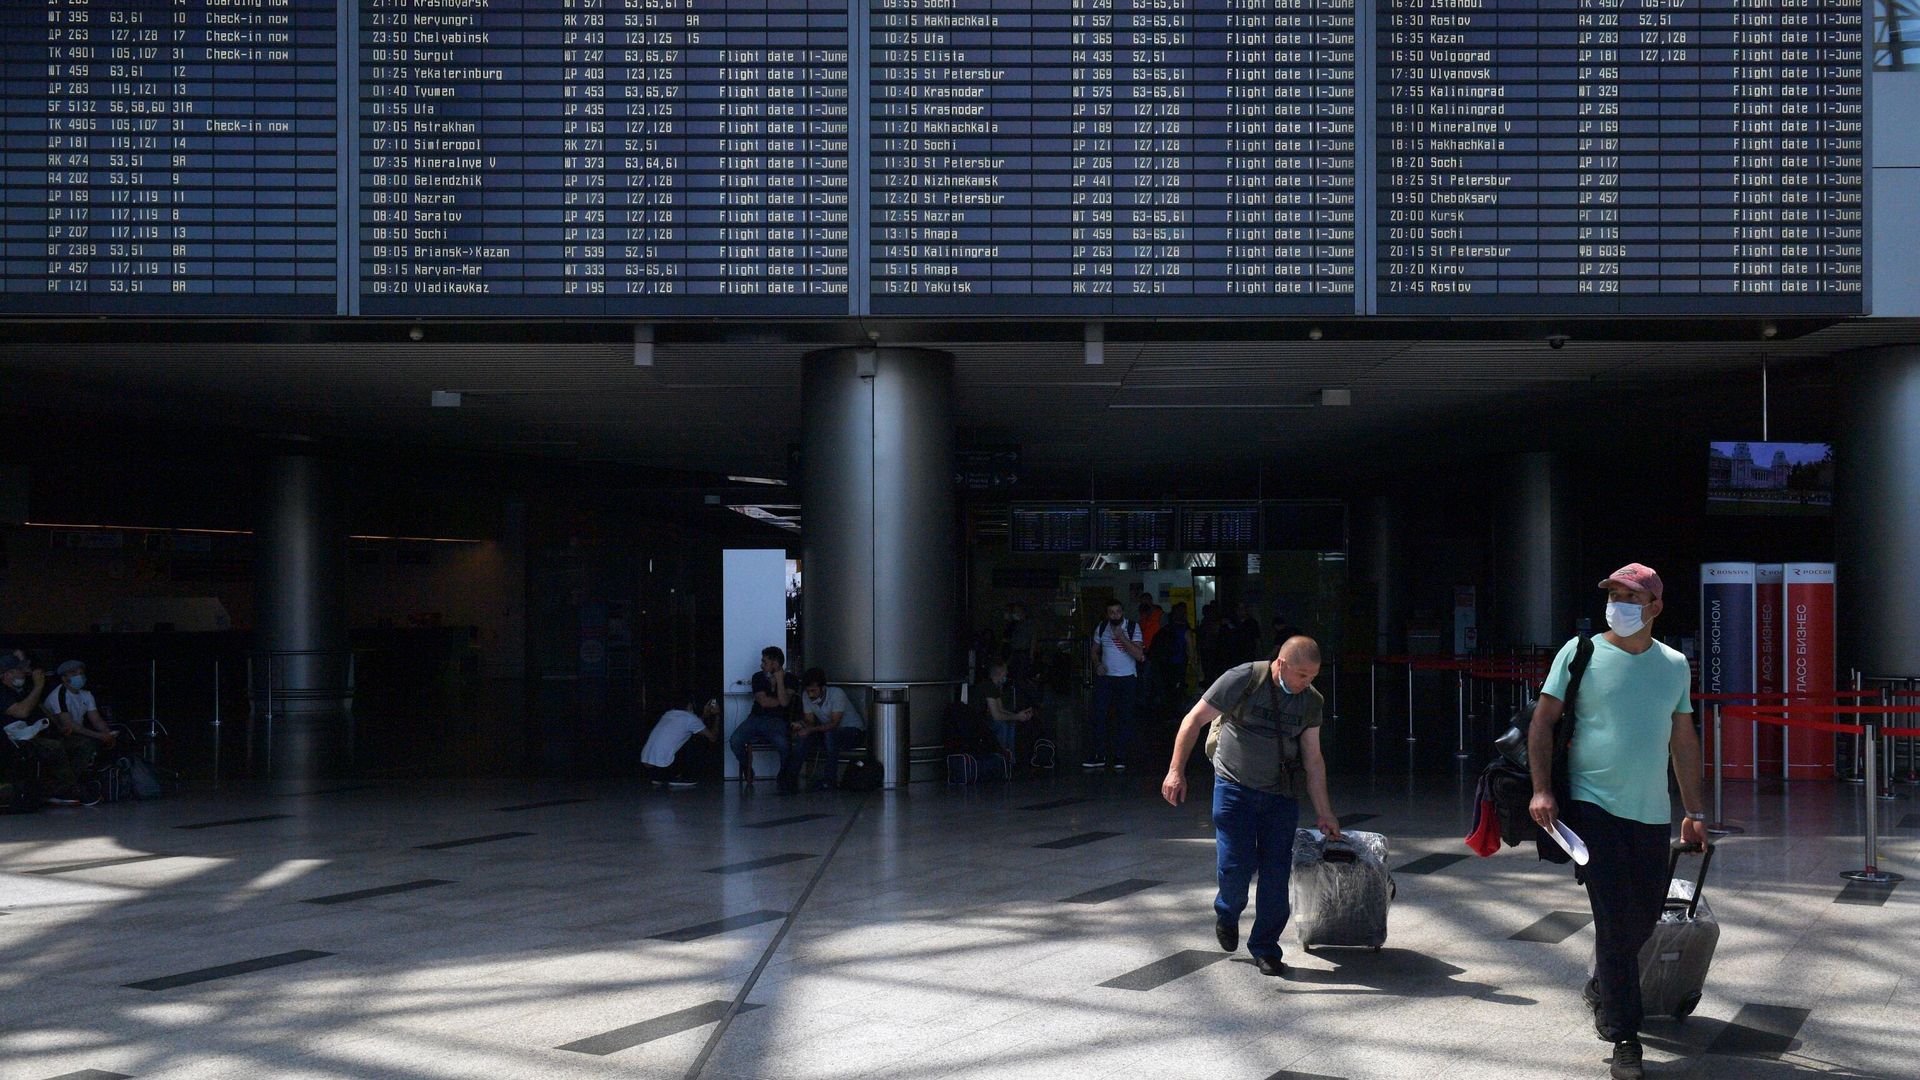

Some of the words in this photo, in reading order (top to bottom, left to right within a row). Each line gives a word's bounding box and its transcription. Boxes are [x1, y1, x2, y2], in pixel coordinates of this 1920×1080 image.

[68, 12, 88, 22] 395
[110, 12, 142, 24] 63,61
[174, 12, 186, 24] 10
[268, 16, 288, 24] now
[1392, 32, 1424, 44] 16:35
[1430, 32, 1464, 44] Kazan
[1598, 32, 1618, 44] 283
[1640, 32, 1686, 44] 127,128
[1734, 32, 1772, 44] Flight
[1782, 32, 1808, 42] date
[1816, 32, 1862, 42] 11-June
[68, 46, 94, 58] 4901
[112, 48, 158, 60] 105,107
[172, 48, 184, 58] 31
[268, 52, 288, 60] now
[372, 50, 406, 60] 00:50
[414, 50, 454, 62] Surgut
[584, 50, 604, 62] 247
[624, 50, 678, 62] 63,65,67
[720, 50, 758, 62] Flight
[768, 50, 794, 62] date
[802, 50, 848, 62] 11-June
[886, 50, 918, 62] 10:25
[924, 50, 964, 62] Elista
[1092, 50, 1112, 62] 435
[1132, 50, 1164, 62] 52,51
[1226, 50, 1266, 62] Flight
[1274, 50, 1300, 62] date
[1310, 50, 1354, 62] 11-June
[1392, 50, 1424, 62] 16:50
[1430, 50, 1490, 62] Volgograd
[1600, 50, 1616, 62] 181
[1640, 50, 1686, 62] 127,128
[1734, 50, 1772, 62] Flight
[1782, 50, 1808, 60] date
[1816, 48, 1862, 60] 11-June
[68, 64, 88, 76] 459
[110, 66, 142, 78] 63,61
[174, 66, 186, 76] 12
[68, 100, 96, 112] 5132
[110, 100, 164, 114] 56,58,60
[374, 102, 408, 114] 01:55
[414, 104, 434, 114] Ufa
[584, 104, 604, 114] 435
[626, 104, 672, 116] 123,125
[720, 104, 758, 116] Flight
[768, 104, 794, 116] date
[802, 104, 848, 116] 11-June
[886, 104, 918, 114] 11:15
[924, 104, 984, 114] Krasnodar
[1094, 104, 1112, 116] 157
[1134, 104, 1180, 116] 127,128
[1226, 104, 1266, 116] Flight
[1274, 104, 1300, 114] date
[1310, 104, 1354, 114] 11-June
[1392, 104, 1424, 114] 18:10
[1430, 104, 1504, 116] Kaliningrad
[1598, 104, 1618, 114] 265
[1734, 102, 1772, 114] Flight
[1782, 102, 1808, 114] date
[1816, 102, 1862, 114] 11-June
[70, 136, 86, 148] 181
[112, 136, 156, 150] 119,121
[174, 138, 186, 148] 14
[374, 138, 408, 150] 07:10
[414, 138, 480, 152] Simferopol
[584, 140, 602, 150] 271
[626, 140, 656, 152] 52,51
[720, 140, 758, 152] Flight
[768, 140, 794, 150] date
[802, 140, 848, 150] 11-June
[884, 156, 918, 168] 11:30
[924, 156, 936, 168] St
[944, 156, 1004, 168] Petersbur
[1092, 158, 1112, 168] 205
[1134, 158, 1180, 170] 127,128
[1226, 158, 1266, 170] Flight
[1274, 158, 1300, 168] date
[1308, 158, 1354, 168] 11-June
[1392, 156, 1424, 168] 18:20
[1430, 156, 1462, 168] Sochi
[1600, 156, 1618, 168] 117
[1734, 156, 1772, 168] Flight
[1782, 156, 1808, 166] date
[1816, 156, 1862, 166] 11-June
[68, 172, 88, 184] 202
[110, 172, 142, 184] 53,51
[172, 174, 180, 184] 9
[374, 192, 408, 204] 08:00
[414, 192, 454, 204] Nazran
[586, 192, 604, 204] 173
[626, 192, 672, 206] 127,128
[720, 192, 758, 206] Flight
[768, 192, 794, 204] date
[802, 192, 848, 204] 11-June
[70, 208, 88, 220] 117
[112, 208, 158, 222] 117,119
[374, 228, 408, 240] 08:50
[414, 228, 446, 240] Sochi
[586, 228, 604, 240] 123
[626, 228, 672, 240] 127,128
[720, 228, 758, 240] Flight
[768, 228, 794, 240] date
[802, 228, 848, 240] 11-June
[886, 228, 918, 240] 13:15
[924, 228, 958, 240] Anapa
[1092, 228, 1112, 240] 459
[1132, 228, 1184, 240] 63-65,61
[1226, 228, 1266, 240] Flight
[1274, 228, 1300, 240] date
[1310, 228, 1354, 240] 11-June
[1390, 228, 1424, 238] 20:00
[1430, 228, 1462, 238] Sochi
[1600, 228, 1618, 238] 115
[1734, 228, 1772, 240] Flight
[1782, 228, 1808, 238] date
[1816, 226, 1862, 238] 11-June
[68, 244, 96, 256] 2389
[110, 244, 142, 256] 53,51
[886, 246, 918, 256] 14:50
[924, 246, 998, 258] Kaliningrad
[1092, 246, 1112, 256] 263
[1134, 246, 1180, 258] 127,128
[1226, 246, 1266, 258] Flight
[1274, 246, 1300, 256] date
[1310, 246, 1354, 256] 11-June
[68, 262, 88, 274] 457
[112, 262, 158, 274] 117,119
[174, 262, 186, 274] 15
[1390, 264, 1424, 274] 20:20
[1430, 264, 1464, 274] Kirov
[1600, 262, 1618, 274] 275
[1734, 262, 1772, 274] Flight
[1782, 262, 1808, 274] date
[1816, 262, 1862, 274] 11-June
[70, 280, 86, 292] 121
[110, 280, 142, 292] 53,51
[1711, 600, 1721, 654] ЭКОНОМ
[1796, 604, 1807, 655] БИЗНЕС
[1711, 657, 1721, 694] ЛАСС
[1796, 657, 1807, 700] ЛАСС
